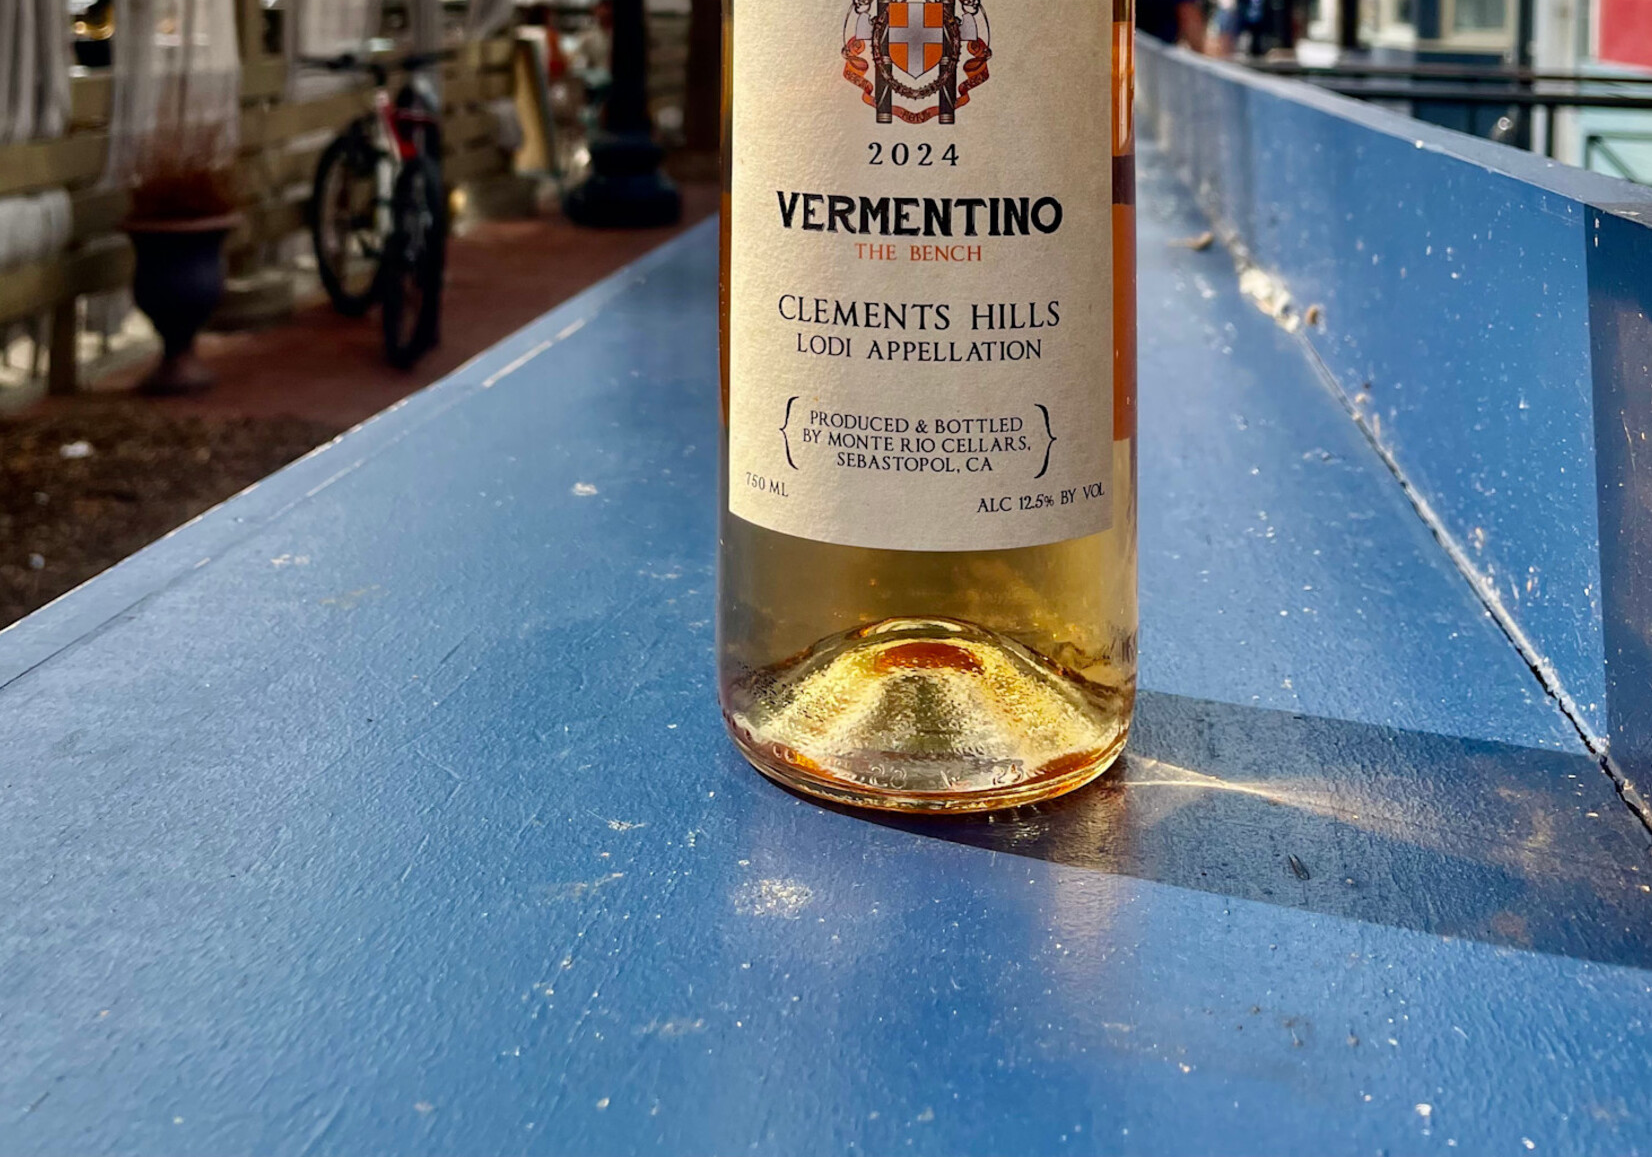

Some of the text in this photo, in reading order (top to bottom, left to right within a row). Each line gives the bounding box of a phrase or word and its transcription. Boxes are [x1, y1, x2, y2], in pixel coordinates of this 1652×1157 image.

[867, 141, 960, 167] 2024
[775, 190, 1063, 237] VERMENTINO
[853, 242, 983, 262] THE BENCH
[777, 293, 1061, 331] CLEMENTS HILLS
[796, 332, 1043, 363] LODI APPELLATION
[809, 409, 1024, 435] PRODUCED & BOTTLED
[802, 427, 822, 444] BY
[827, 431, 895, 452] MONTE
[900, 437, 936, 454] RIO
[836, 451, 994, 475] SEBASTOPOL, CA
[745, 471, 790, 498] 750 ML
[976, 481, 1106, 514] ALC 12.5% BY VOL
